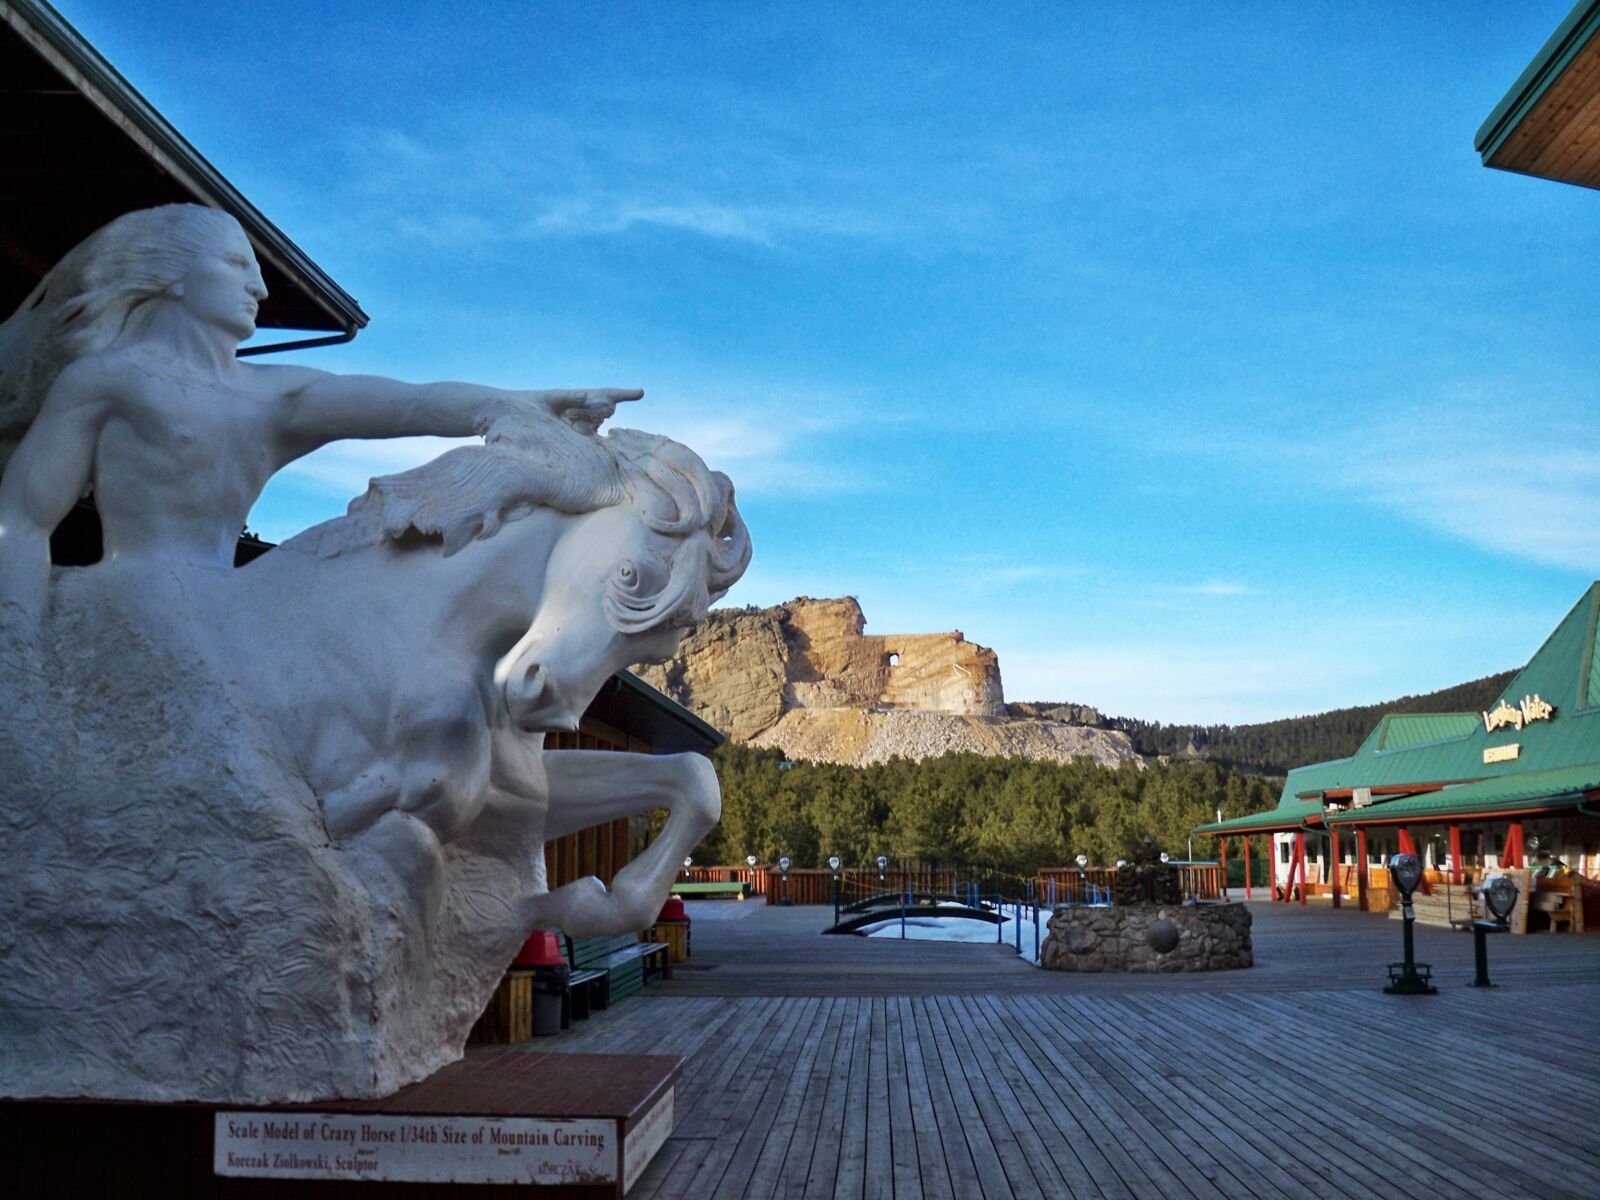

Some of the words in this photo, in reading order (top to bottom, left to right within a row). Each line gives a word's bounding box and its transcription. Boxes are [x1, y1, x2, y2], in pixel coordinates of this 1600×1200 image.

[1520, 694, 1552, 724] Water
[228, 1121, 259, 1139] Scale
[263, 1122, 299, 1140] Model
[303, 1122, 316, 1140] of
[321, 1123, 356, 1146] Crazy
[361, 1125, 396, 1142] Horse
[401, 1125, 437, 1143] 1/34th
[442, 1126, 467, 1144] Size
[472, 1126, 486, 1144] of
[490, 1127, 549, 1146] Mountain
[555, 1128, 605, 1151] Carving
[228, 1152, 269, 1168] Korczak
[335, 1155, 379, 1175] Sculptor
